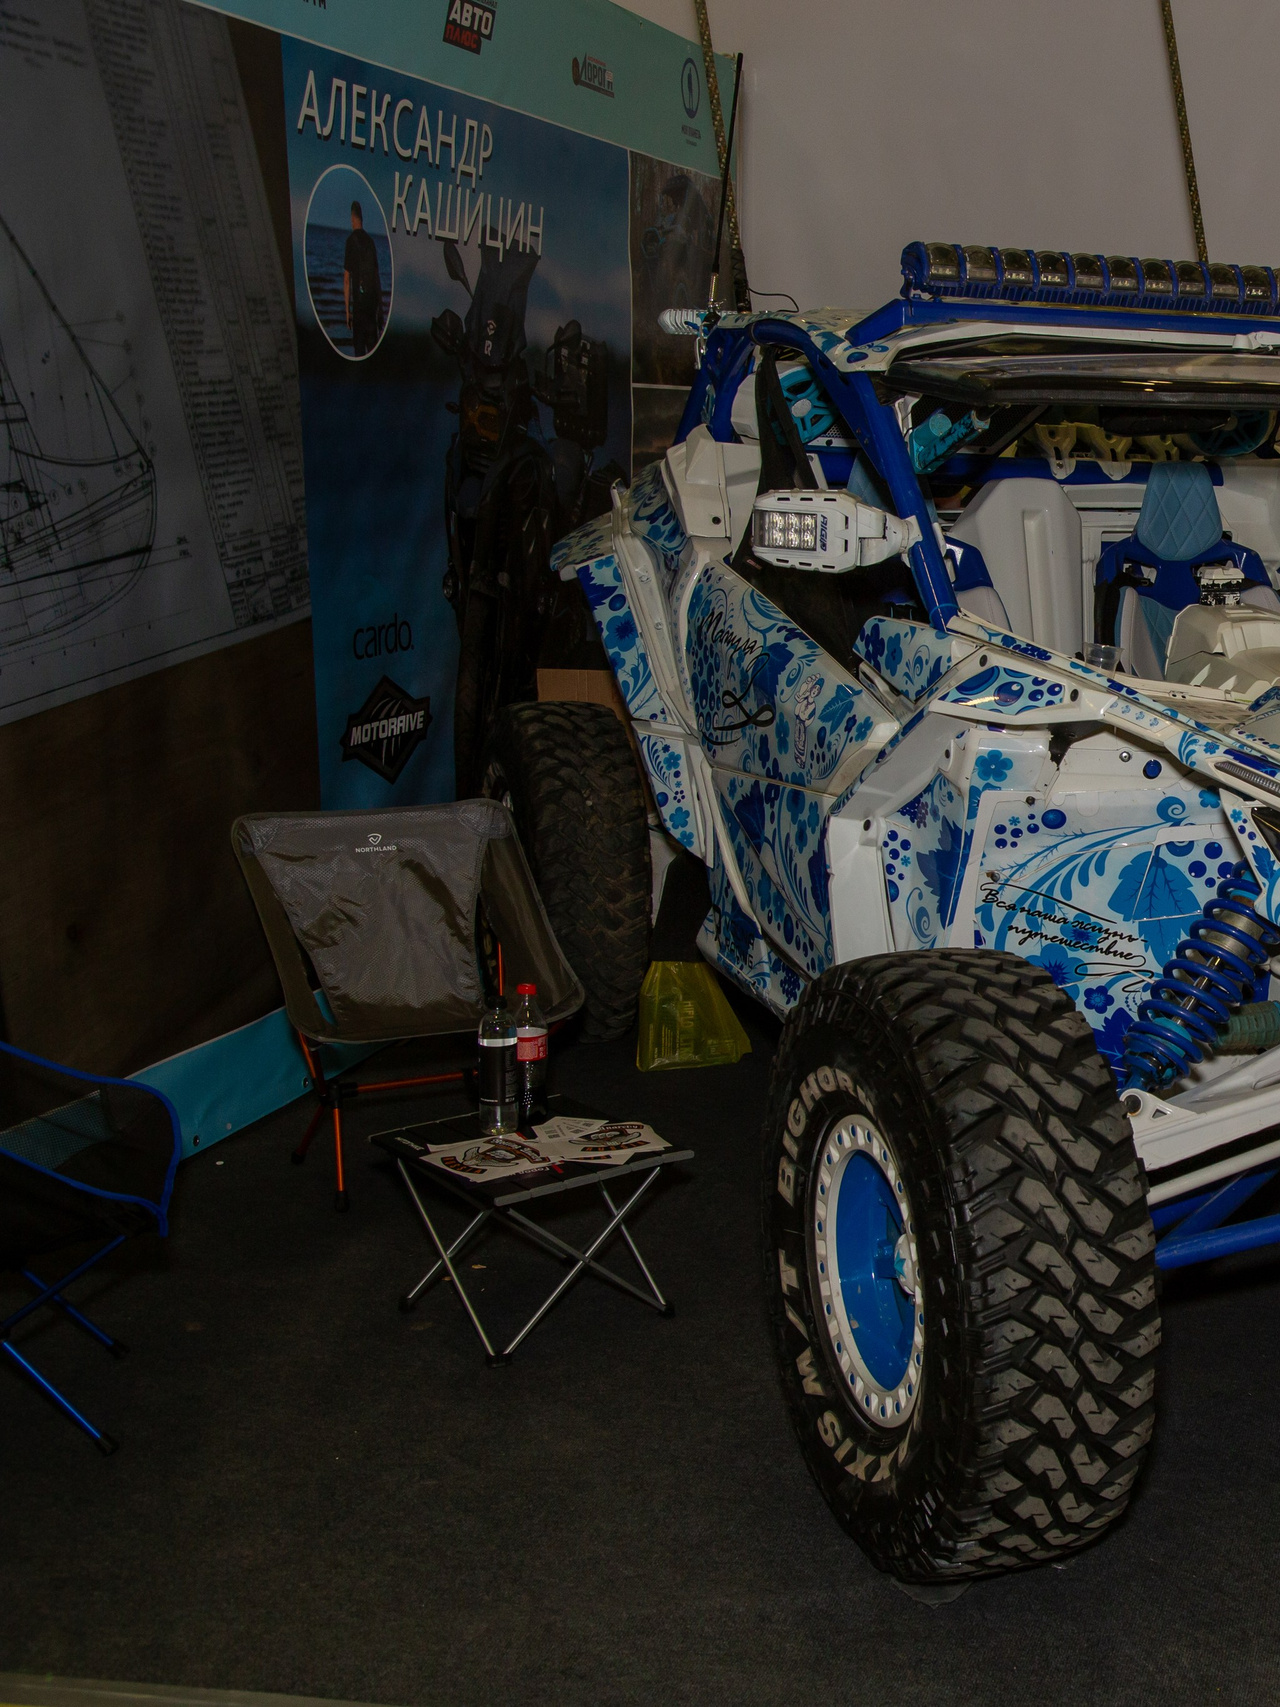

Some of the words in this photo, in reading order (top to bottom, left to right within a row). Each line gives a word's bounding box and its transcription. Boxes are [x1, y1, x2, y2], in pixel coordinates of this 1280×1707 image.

[449, 0, 493, 36] АВТО
[297, 70, 494, 189] АЛЕКСАНДР
[392, 171, 545, 263] КАШИЦИН
[355, 845, 398, 853] NORTHLAND
[980, 887, 1018, 911] Вся
[1020, 903, 1069, 925] наша
[1071, 917, 1139, 943] жизнь
[1007, 923, 1134, 961] путешествие
[777, 1065, 877, 1208] BIGHORN
[816, 1400, 922, 1484] AXXIS
